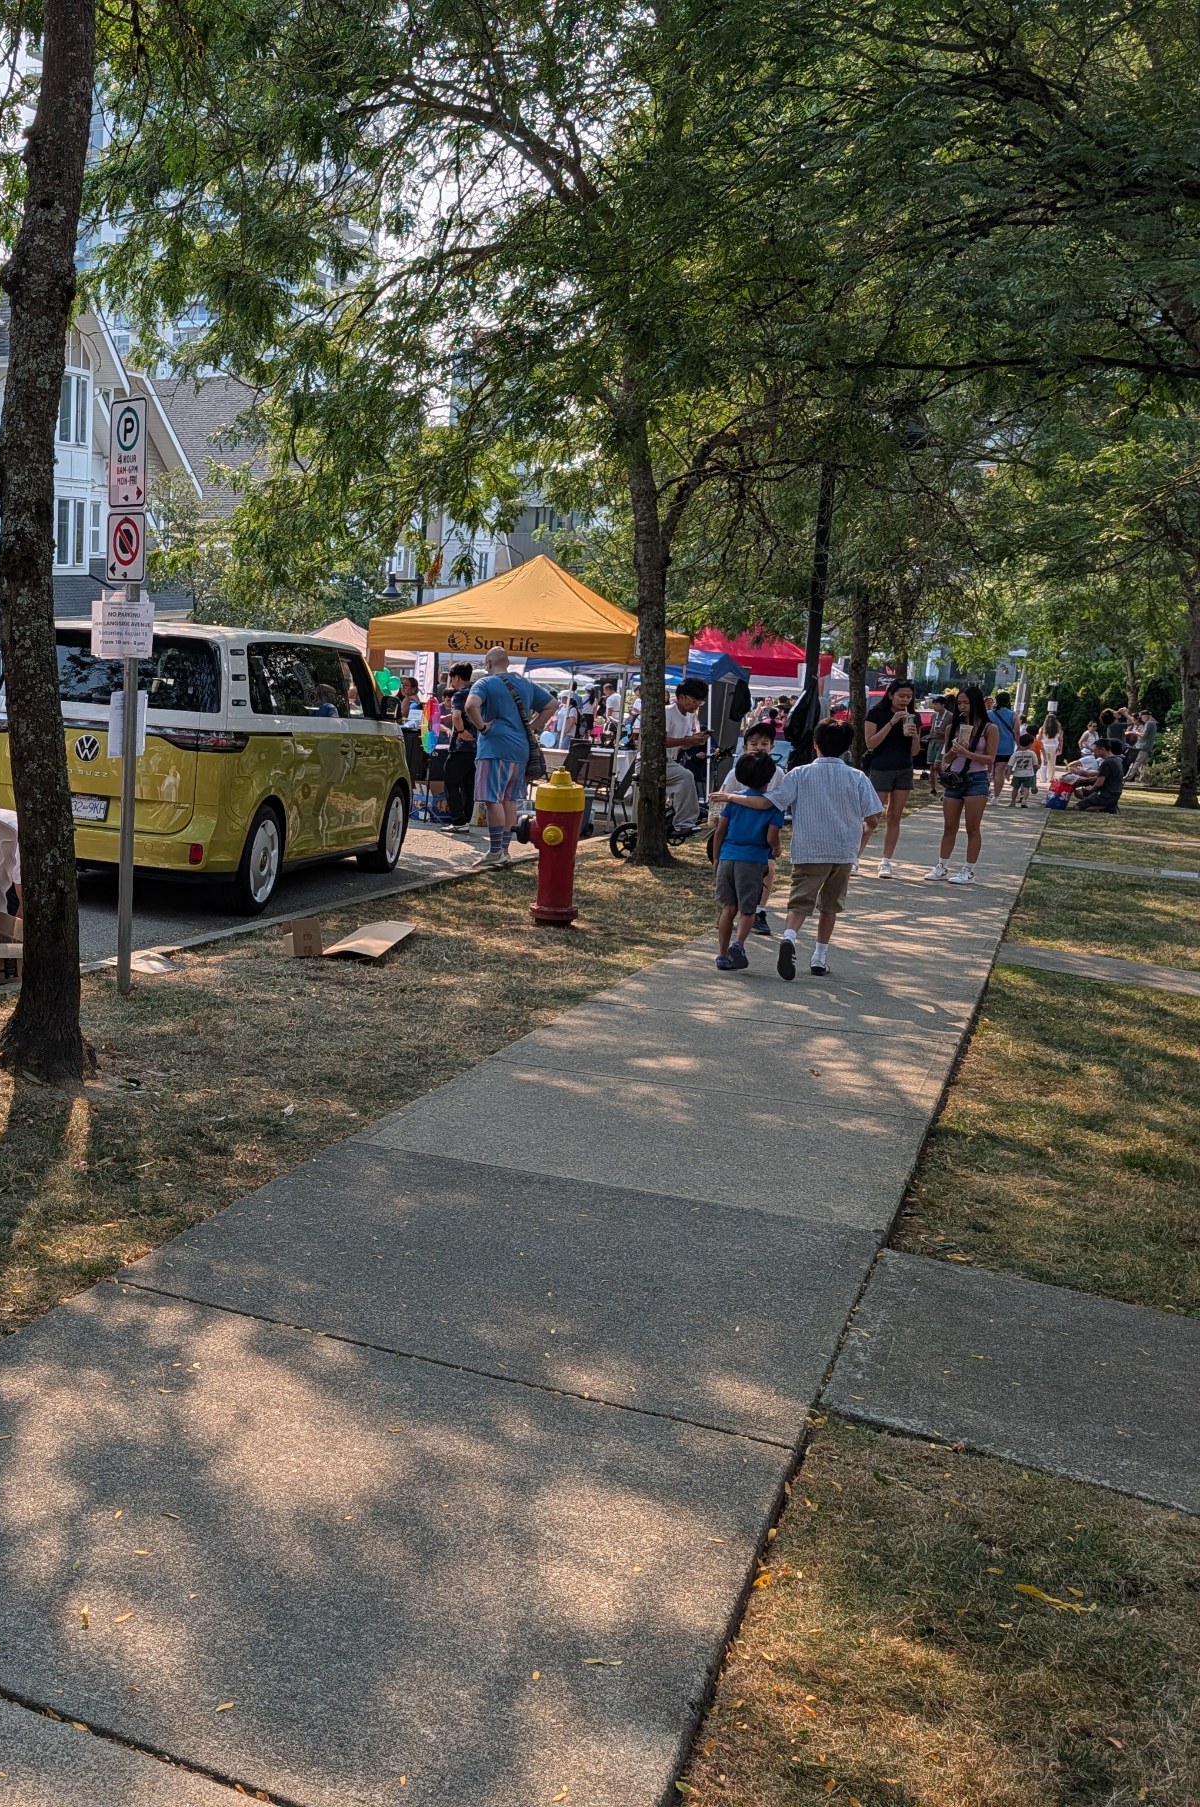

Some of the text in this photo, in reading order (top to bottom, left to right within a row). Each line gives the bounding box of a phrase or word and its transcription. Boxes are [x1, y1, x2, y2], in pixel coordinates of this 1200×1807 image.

[123, 417, 135, 442] P
[123, 454, 137, 464] HOUR
[473, 635, 540, 653] Sun Life
[78, 769, 109, 778] BUZZ
